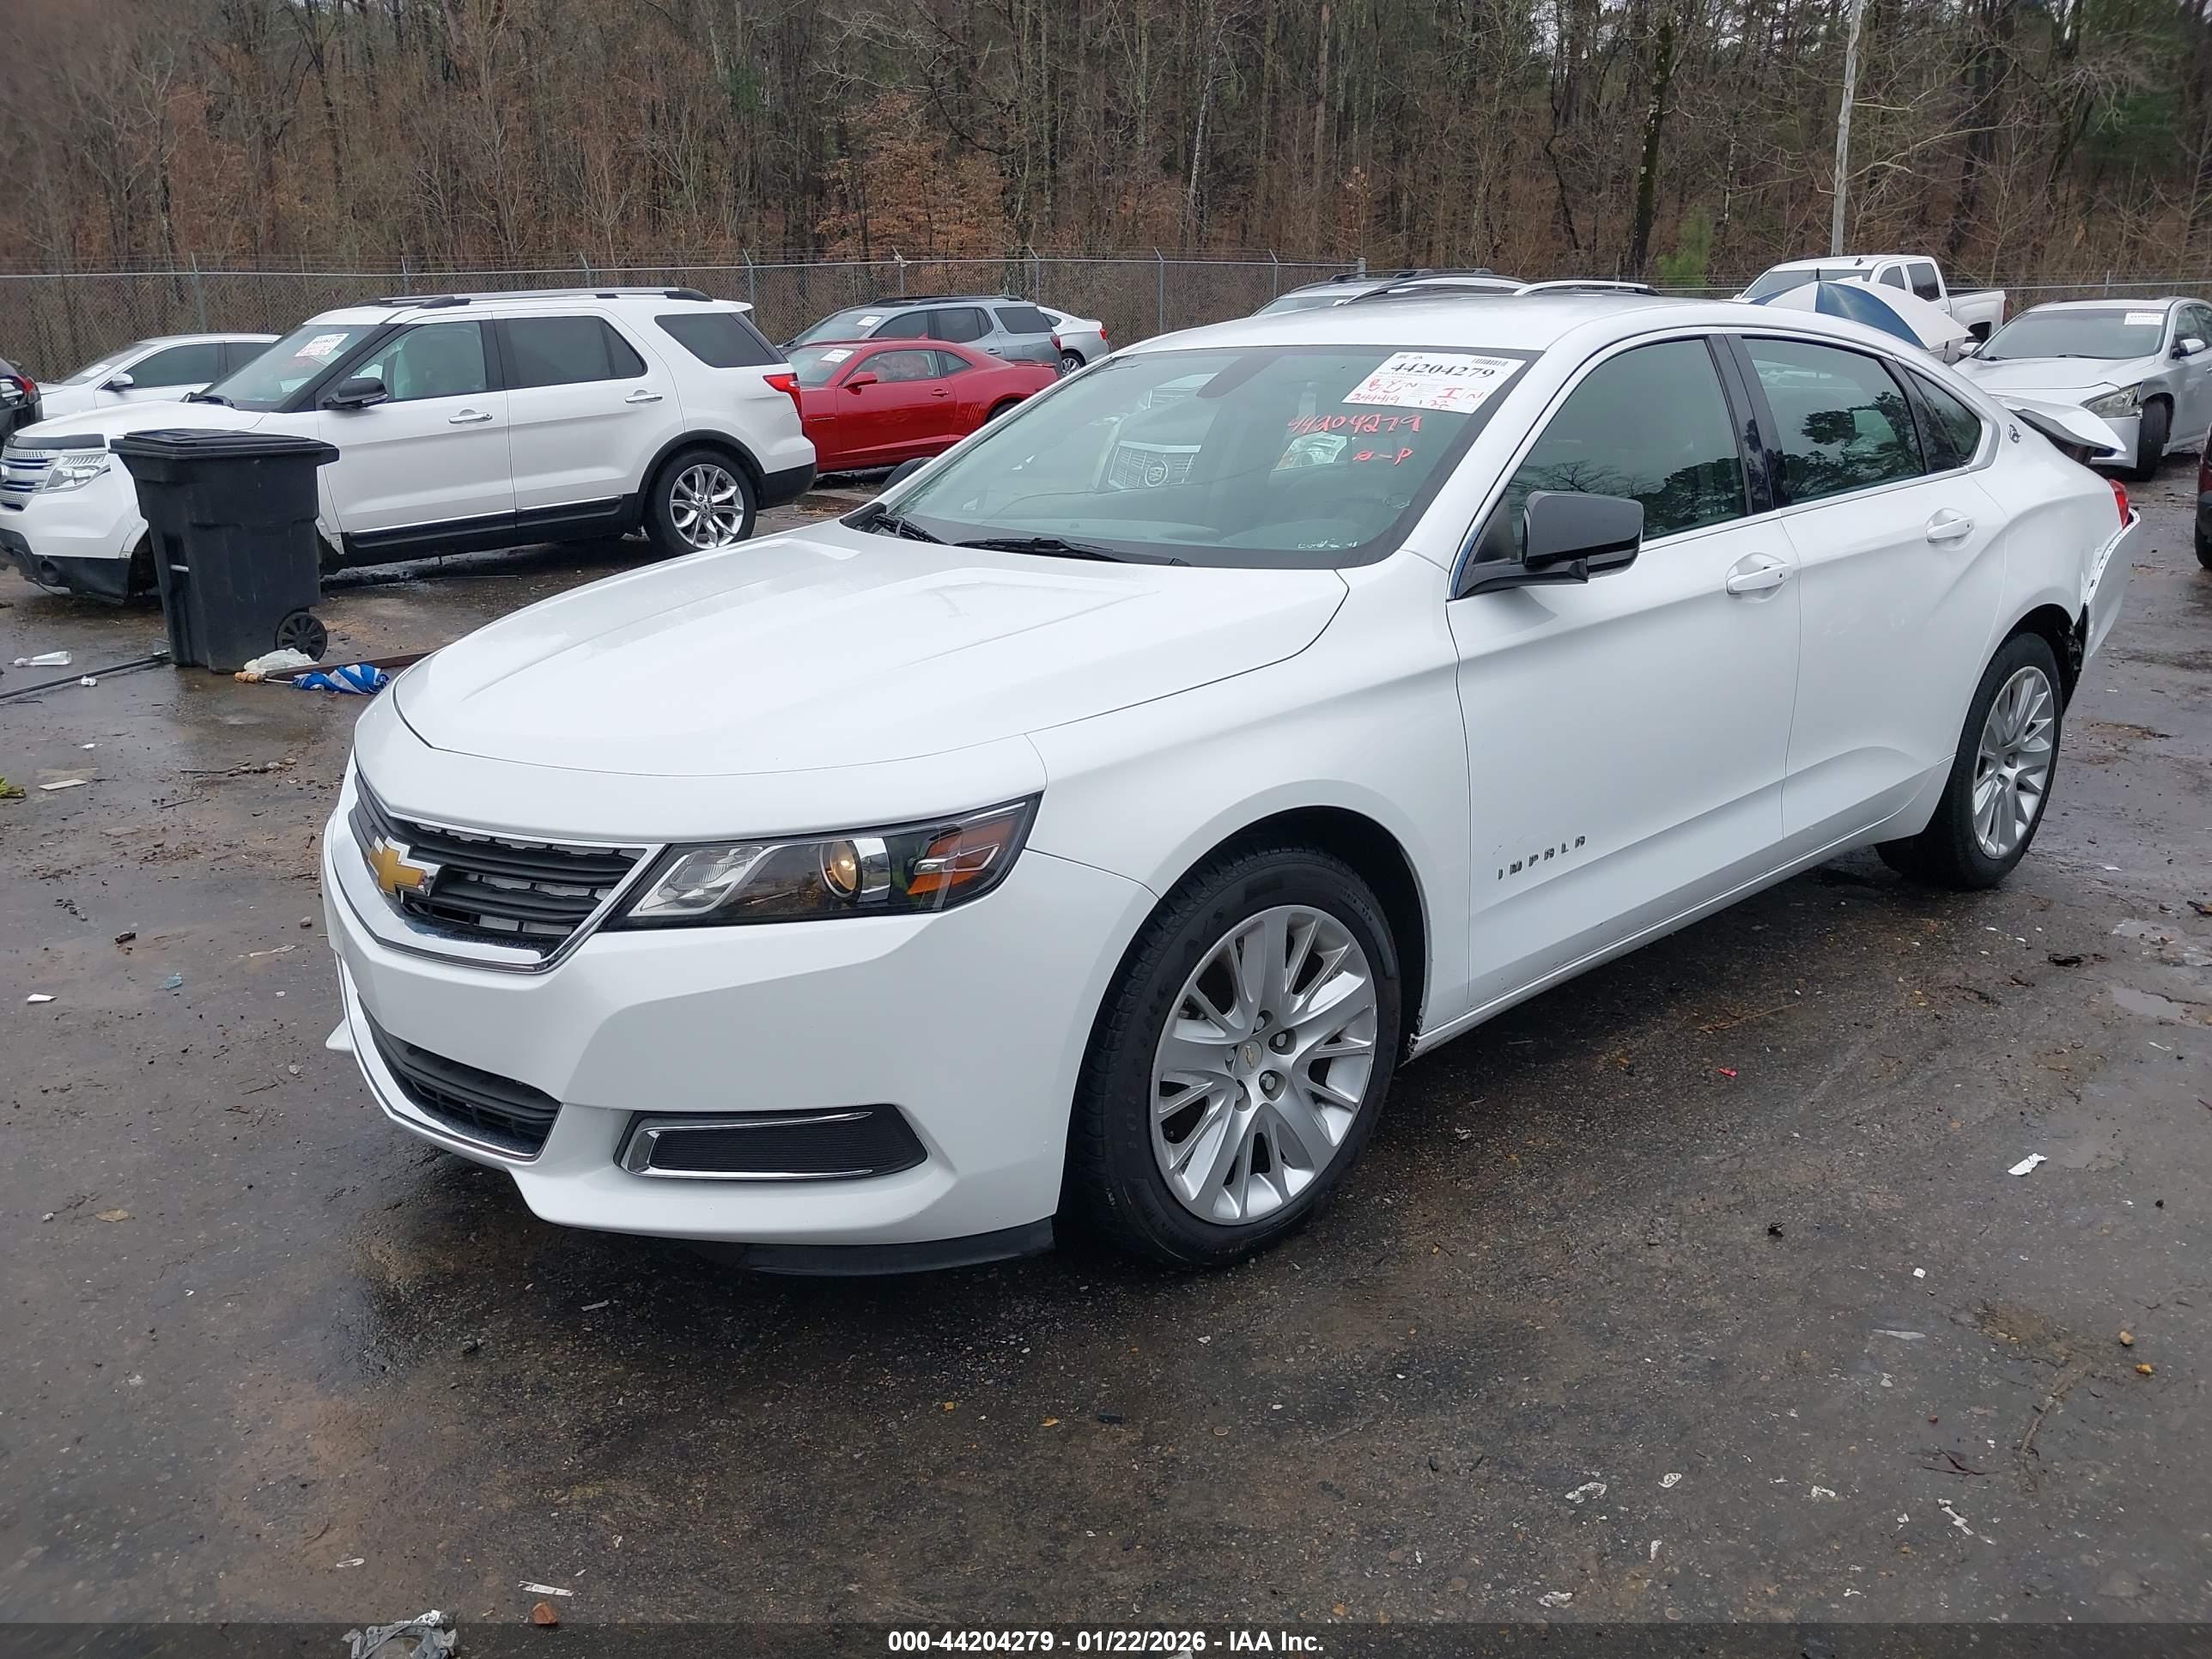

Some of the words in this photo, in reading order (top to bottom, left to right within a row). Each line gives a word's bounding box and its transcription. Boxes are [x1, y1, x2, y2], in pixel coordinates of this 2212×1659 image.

[1390, 362, 1496, 379] 44204279
[1287, 413, 1422, 434] 44204279
[1498, 836, 1586, 880] IMPALA
